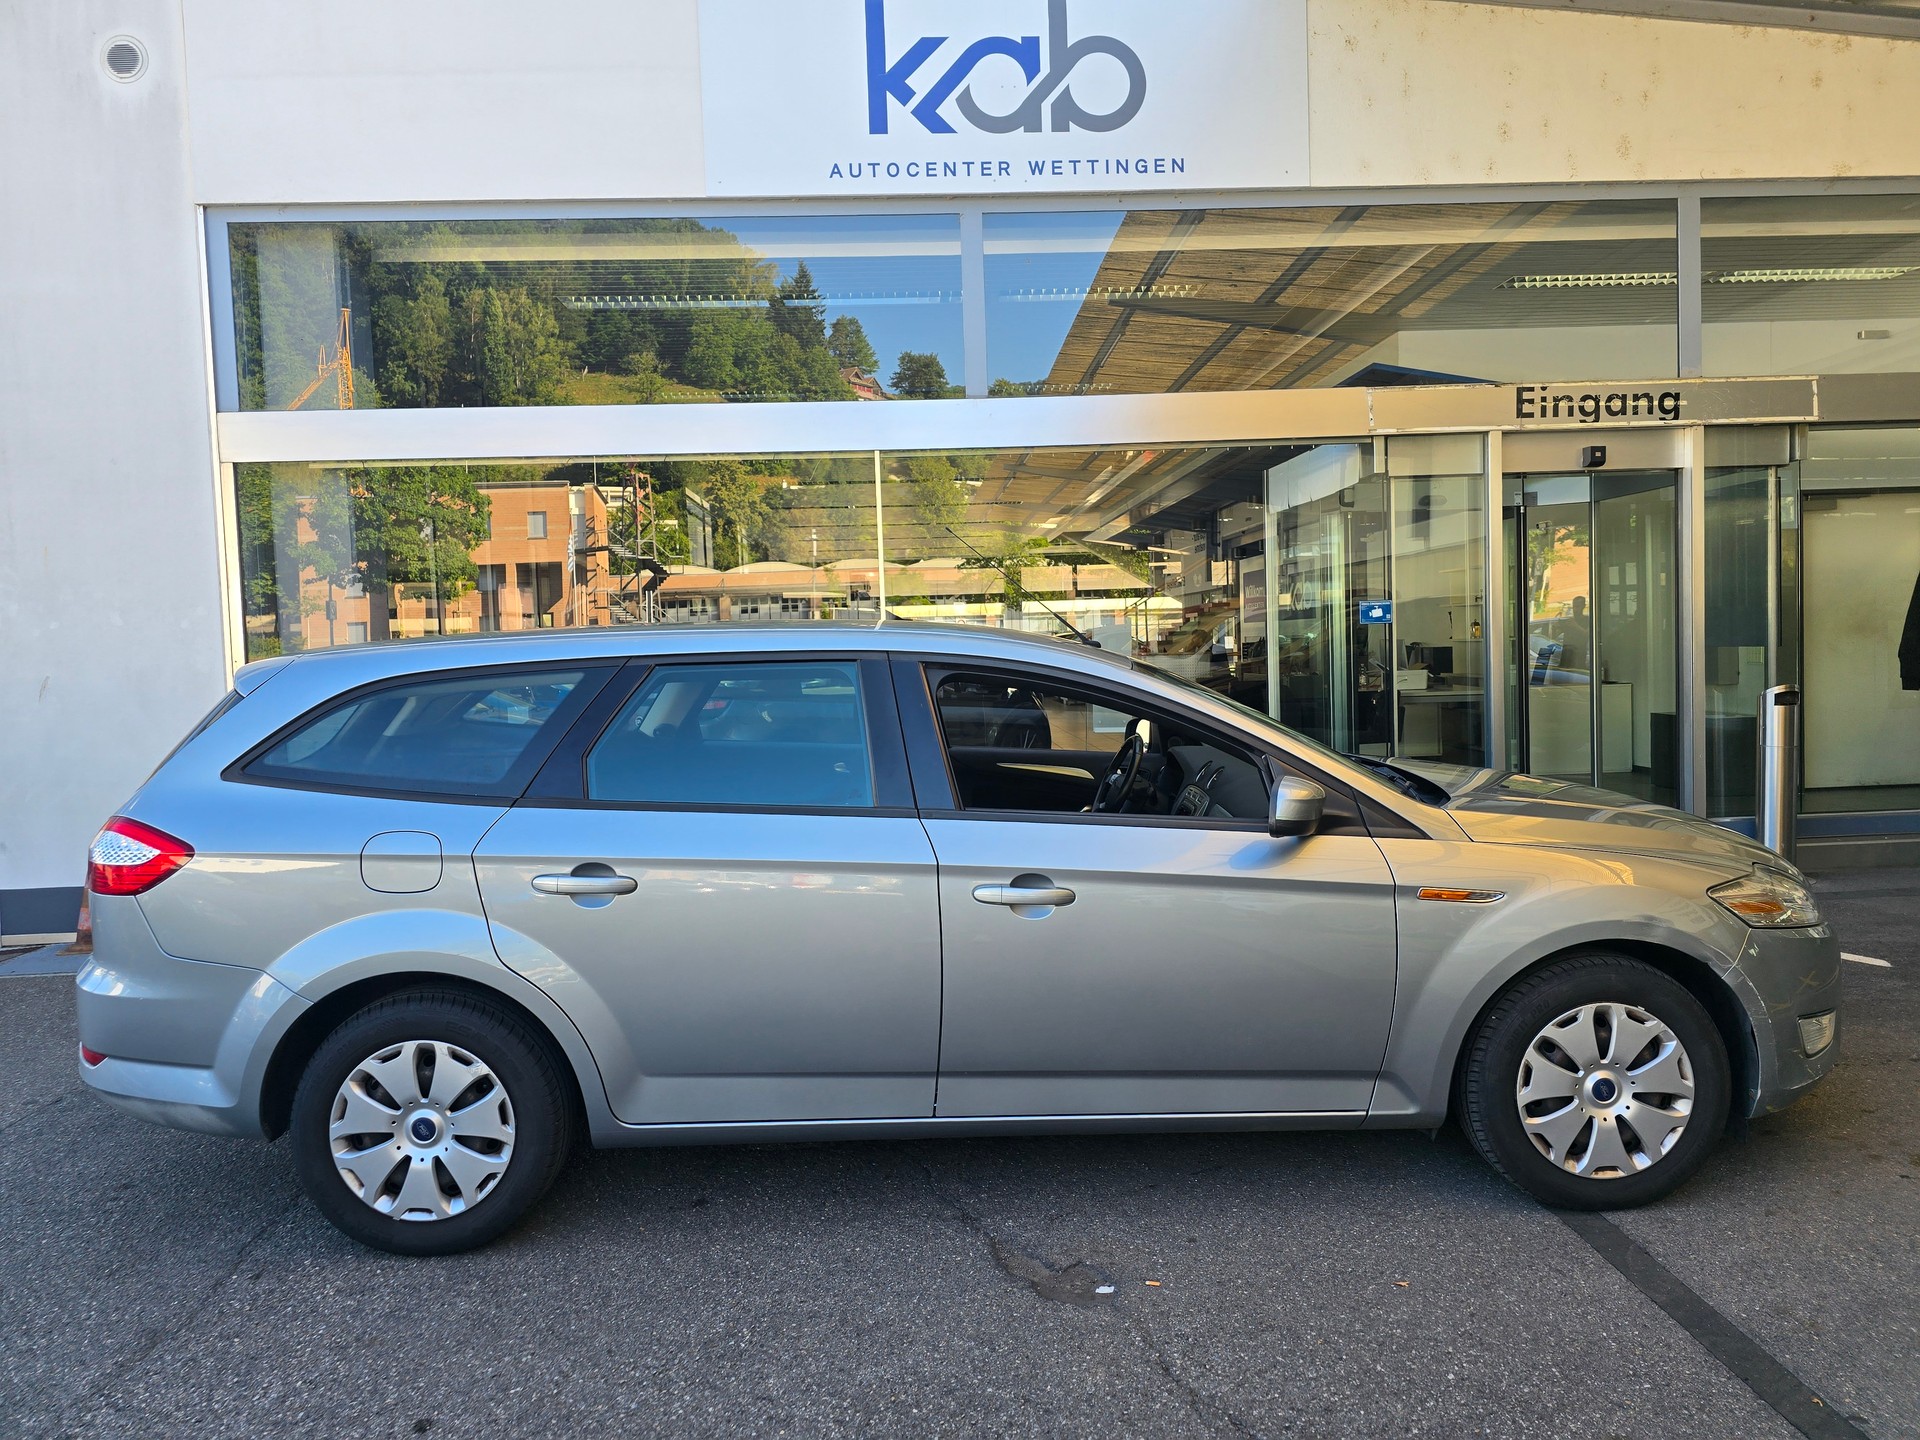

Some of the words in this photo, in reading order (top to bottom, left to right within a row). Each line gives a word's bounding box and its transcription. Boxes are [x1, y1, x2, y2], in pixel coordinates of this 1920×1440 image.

[865, 0, 1147, 135] kab
[829, 160, 1012, 179] AUTOCENTER
[1027, 157, 1187, 176] WETTINGEN
[1516, 386, 1681, 423] Eingang
